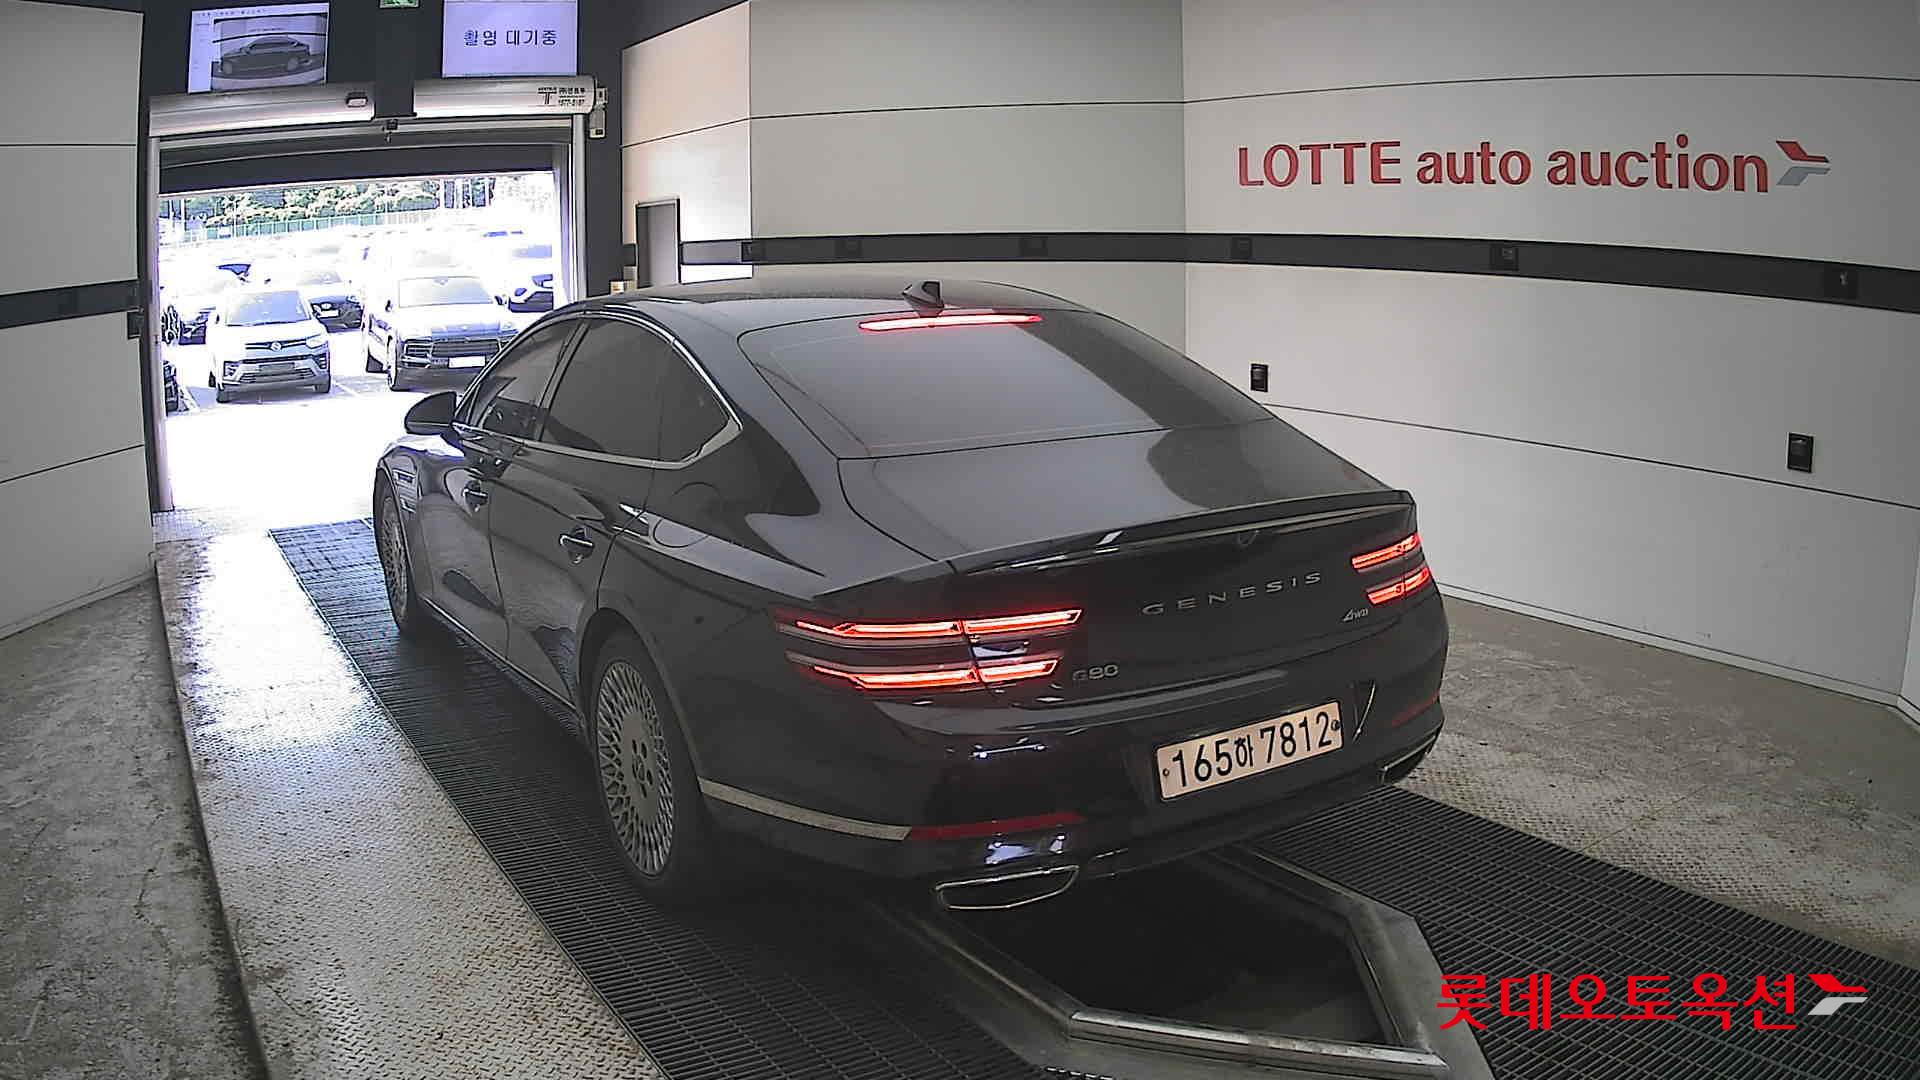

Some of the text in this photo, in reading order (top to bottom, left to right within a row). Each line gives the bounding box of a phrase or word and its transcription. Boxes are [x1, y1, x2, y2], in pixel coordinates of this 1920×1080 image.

[506, 29, 557, 46] 대기중
[1239, 134, 1768, 193] LOTTE auto auction
[1142, 572, 1321, 615] GENESIS
